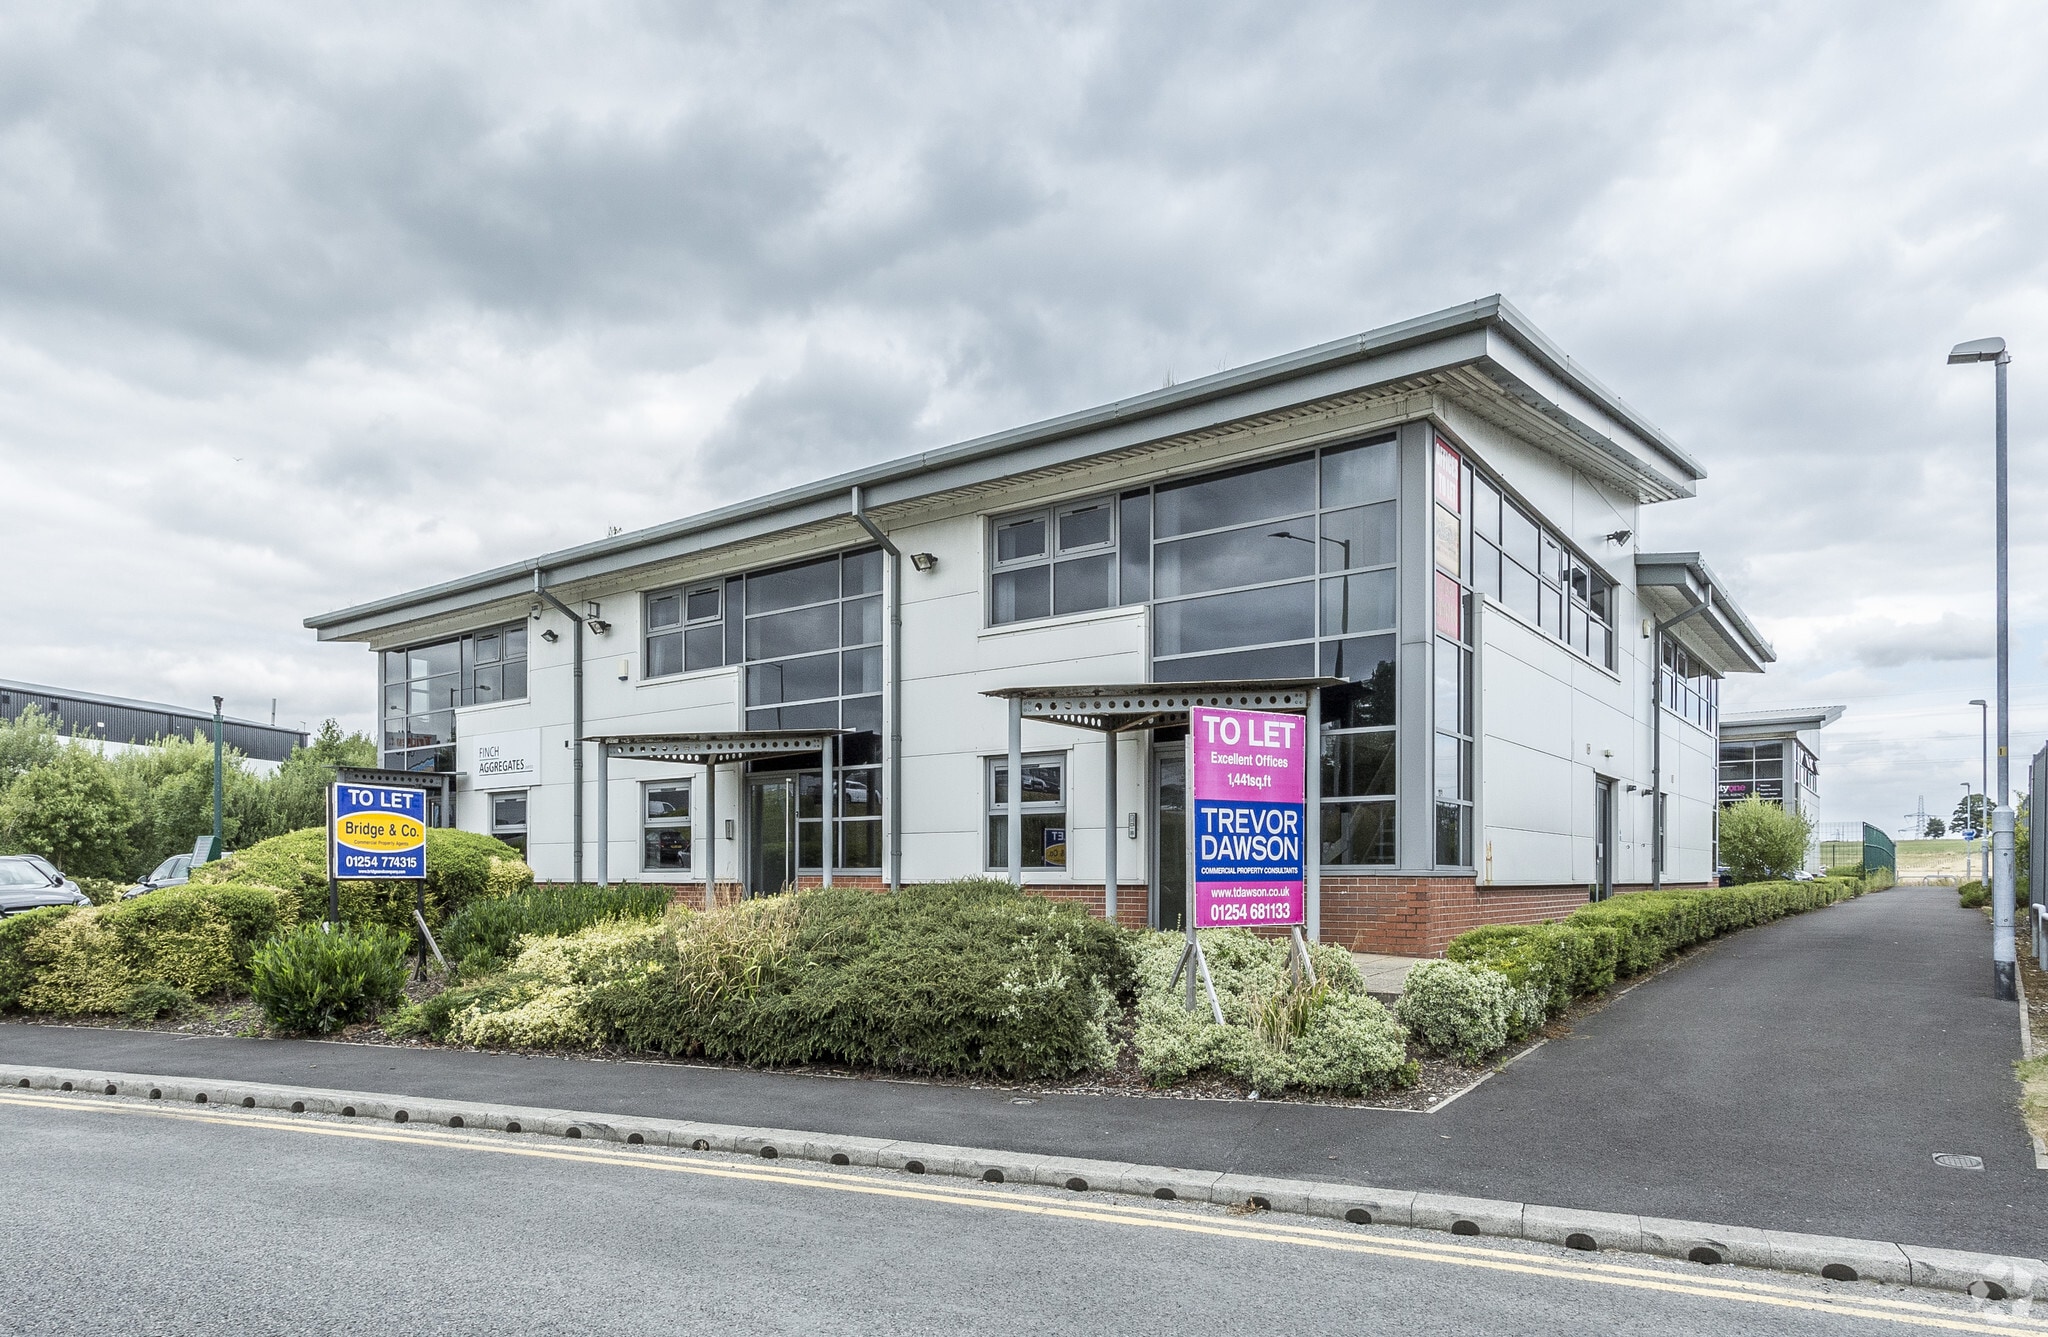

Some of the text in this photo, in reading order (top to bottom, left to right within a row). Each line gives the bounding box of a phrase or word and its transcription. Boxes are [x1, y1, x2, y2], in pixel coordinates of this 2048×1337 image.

[1202, 715, 1296, 749] TO LET
[479, 746, 500, 758] FINCH
[1210, 751, 1289, 768] Excellent Offices
[479, 758, 525, 773] AGGREGATES
[1227, 772, 1272, 790] 1,441sq.ft
[1718, 784, 1746, 793] tyone
[347, 789, 414, 809] TO LET
[1200, 807, 1298, 834] TREVOR
[345, 821, 420, 839] Bridge & Co.
[1201, 835, 1299, 861] DAWSON
[345, 855, 418, 868] 01254 774315
[1201, 867, 1299, 875] COMMERCIAL PROPERTY CONSULTANTS
[1210, 886, 1290, 898] www.tdawson.co.uk
[1210, 902, 1291, 921] 01254 681133
